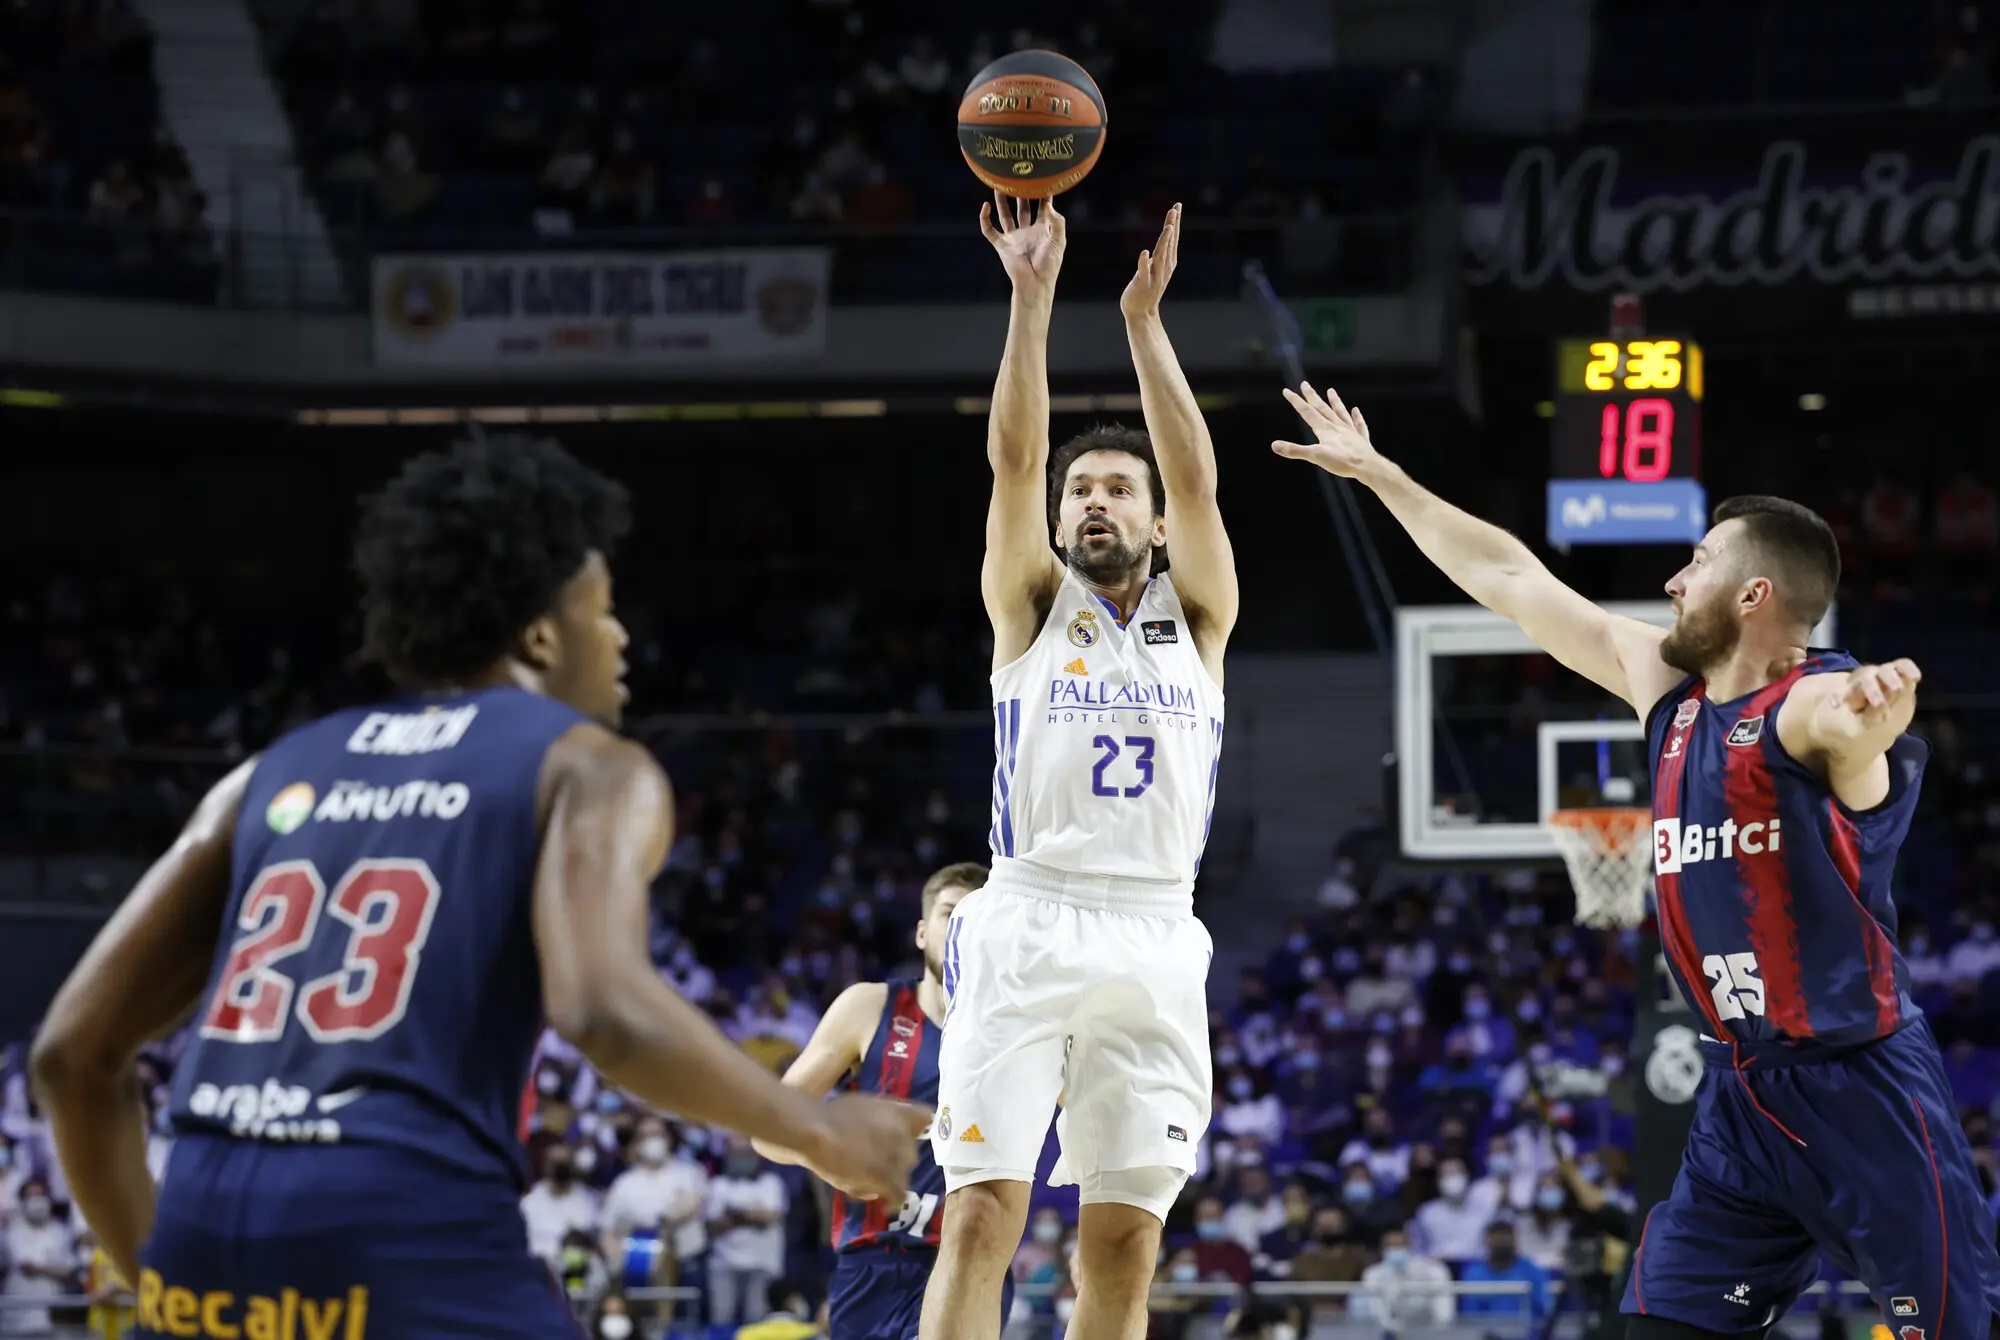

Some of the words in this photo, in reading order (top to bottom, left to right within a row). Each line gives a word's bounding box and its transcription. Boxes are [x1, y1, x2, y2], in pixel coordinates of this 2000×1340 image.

[976, 133, 1074, 160] SPALDING
[1466, 135, 2000, 293] Madrid
[1600, 398, 1674, 482] 18
[1147, 634, 1177, 642] endesa
[1050, 679, 1195, 710] PALLADIUM
[1048, 713, 1117, 724] HOTEL
[1138, 714, 1197, 731] GROUP
[1092, 734, 1155, 798] 23
[201, 857, 441, 1043] 23
[1702, 952, 1765, 1021] 25
[1169, 1130, 1184, 1140] acb
[1723, 1293, 1750, 1306] KELME
[1895, 1303, 1912, 1313] acb
